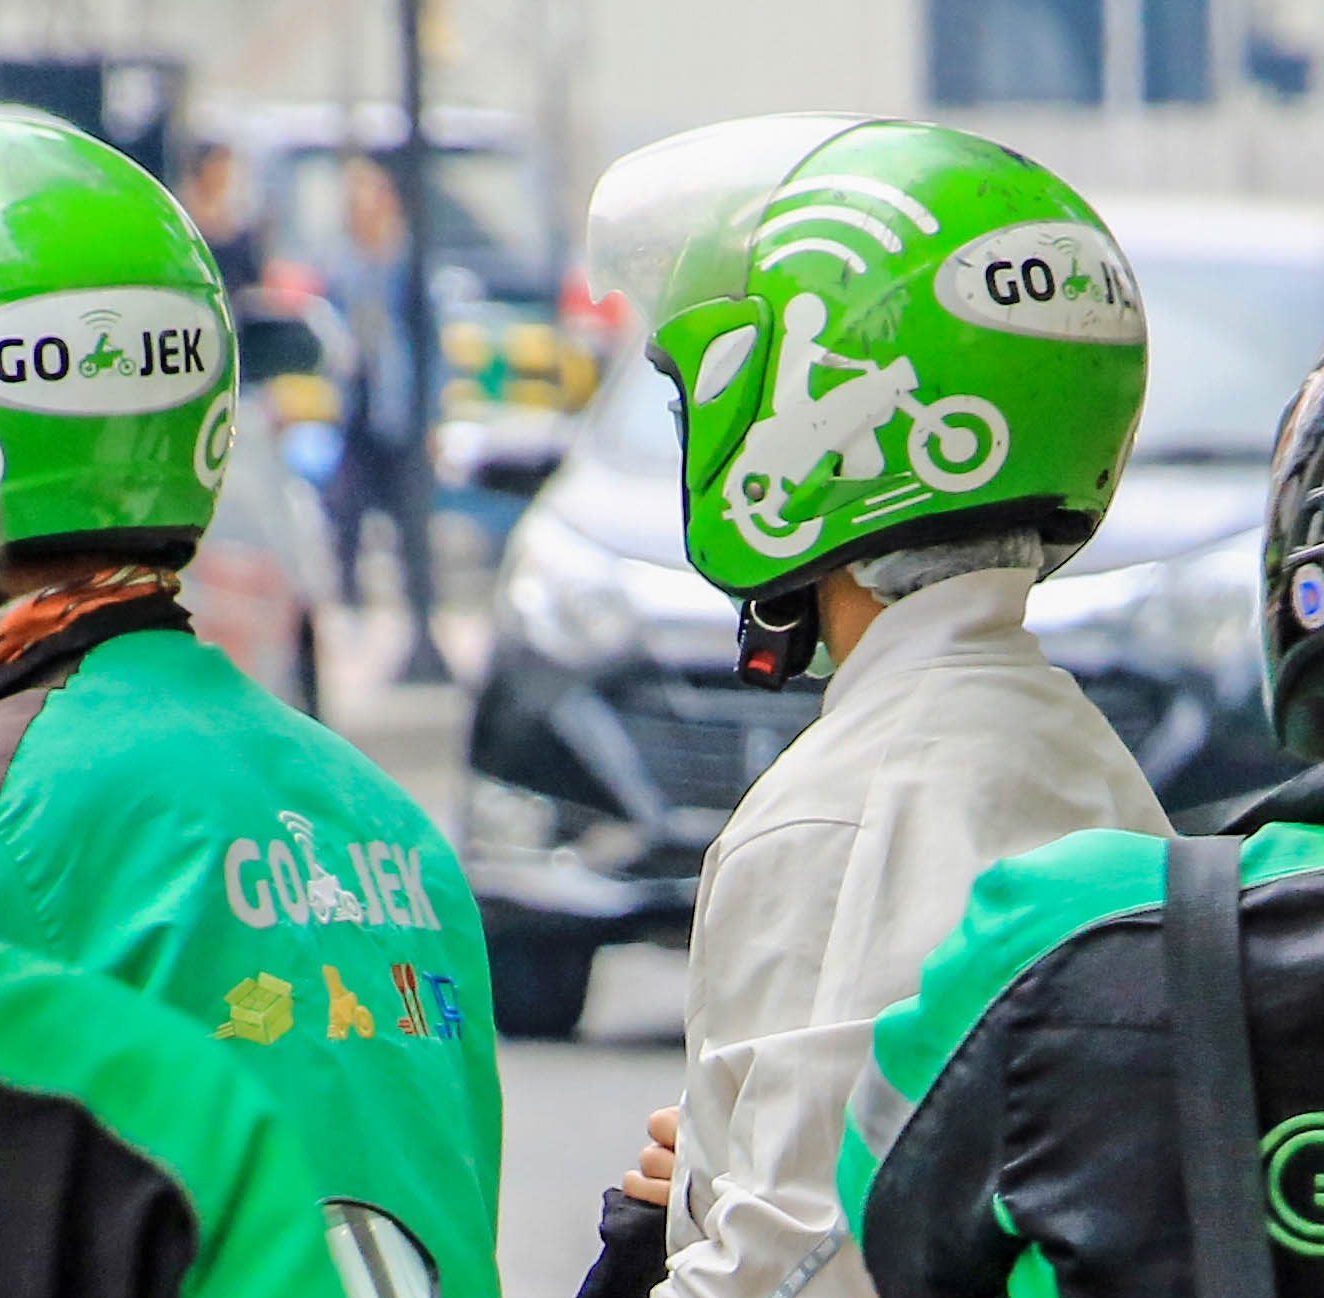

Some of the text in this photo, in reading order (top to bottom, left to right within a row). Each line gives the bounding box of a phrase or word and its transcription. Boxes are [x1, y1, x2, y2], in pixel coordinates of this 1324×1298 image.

[985, 258, 1055, 305] GO
[140, 328, 204, 376] JEK
[224, 838, 442, 931] GO JEK
